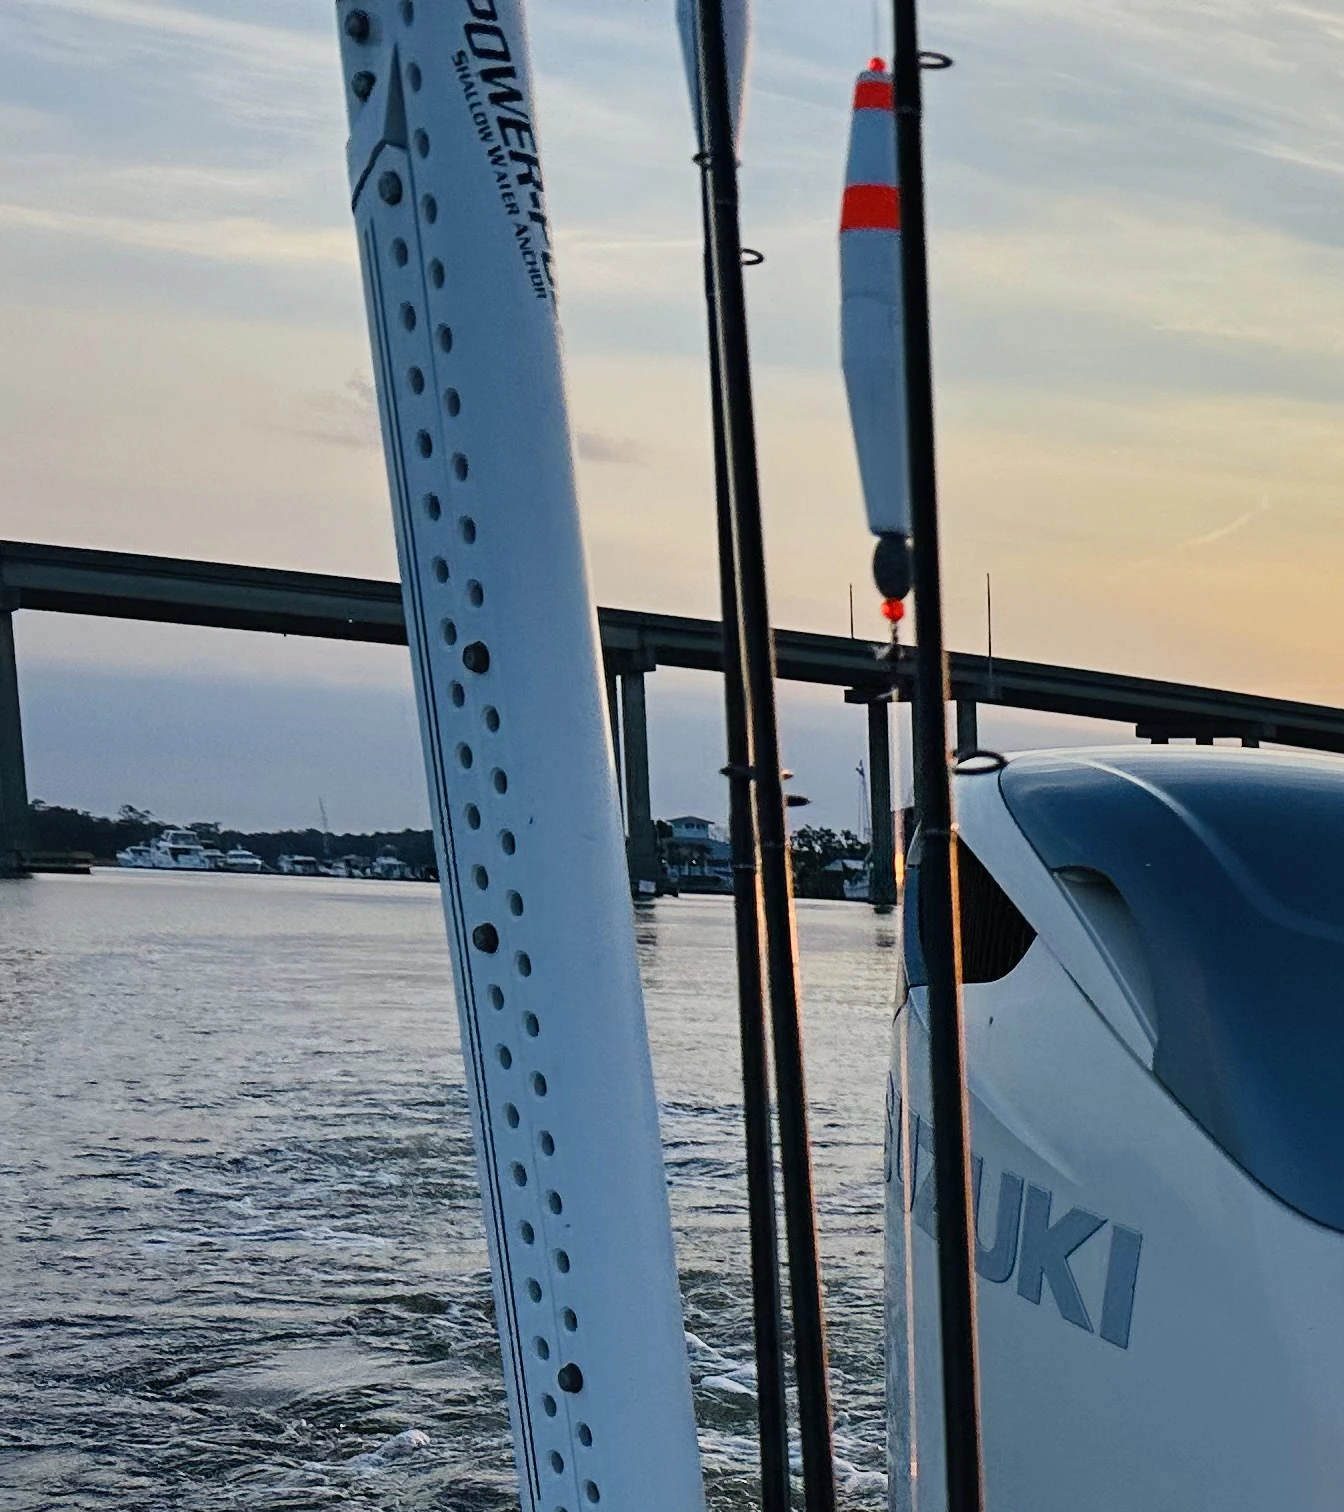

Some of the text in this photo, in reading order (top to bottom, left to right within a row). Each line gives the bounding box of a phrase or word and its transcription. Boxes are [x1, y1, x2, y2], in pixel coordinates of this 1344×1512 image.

[452, 50, 547, 299] SHALLOW WATER ANCHOR
